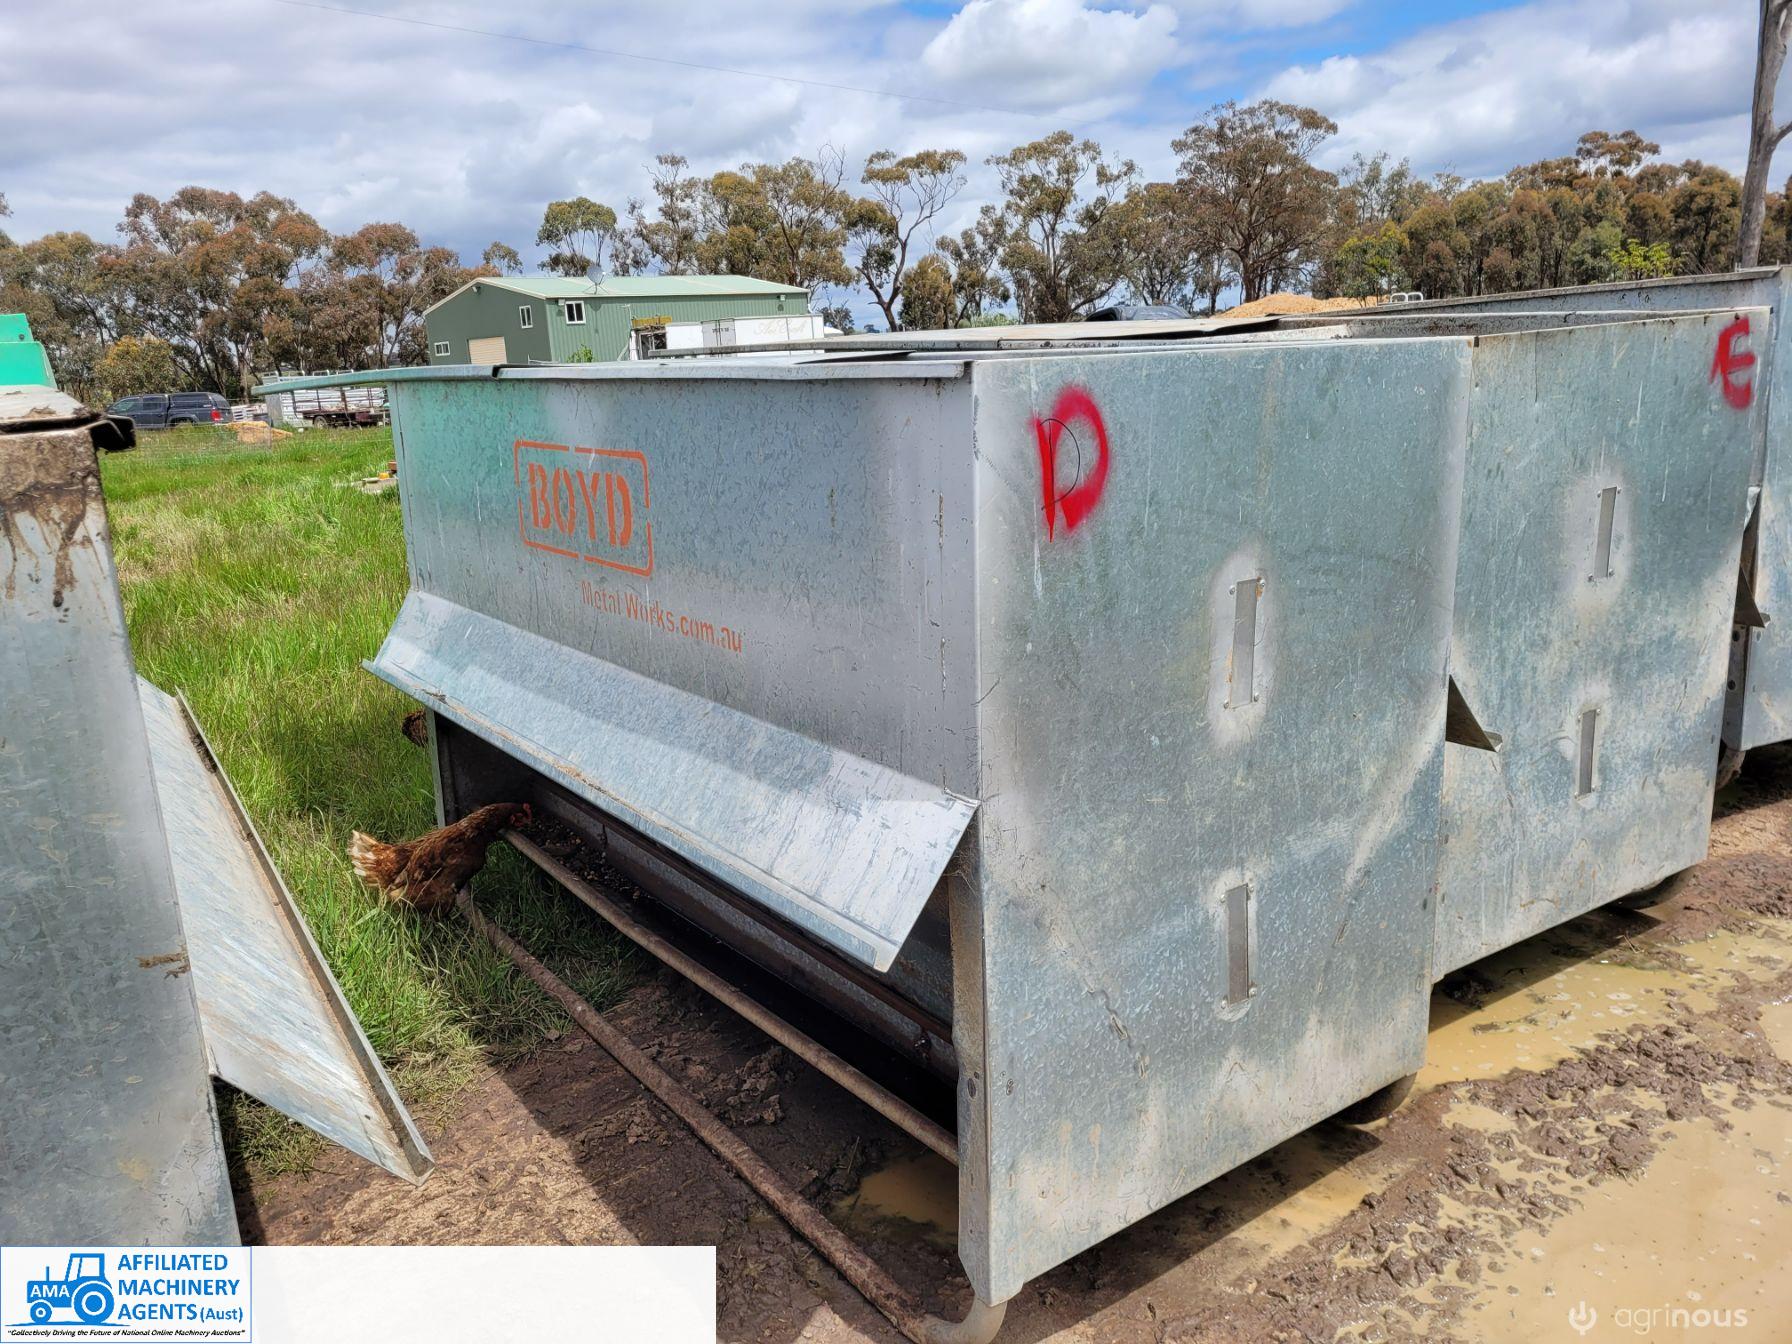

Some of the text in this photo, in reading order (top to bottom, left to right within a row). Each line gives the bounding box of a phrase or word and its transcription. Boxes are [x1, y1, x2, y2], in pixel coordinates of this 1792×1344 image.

[1709, 315, 1756, 410] E
[527, 462, 632, 547] BOYD
[1028, 383, 1110, 543] D
[580, 579, 621, 616] Metal
